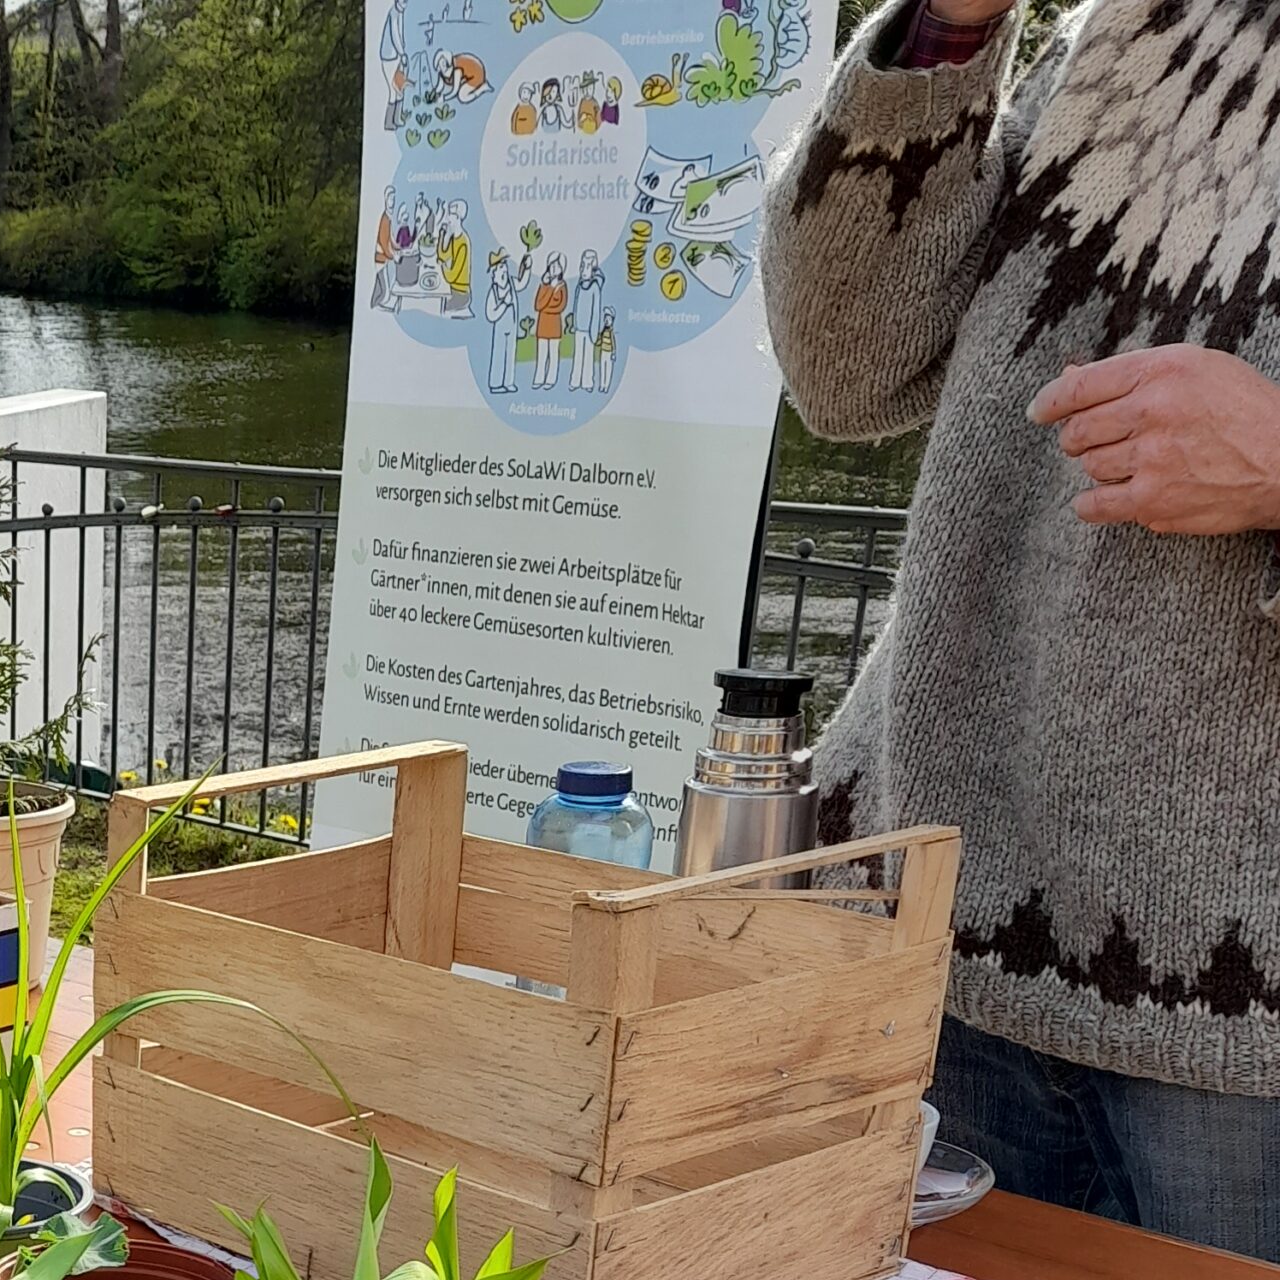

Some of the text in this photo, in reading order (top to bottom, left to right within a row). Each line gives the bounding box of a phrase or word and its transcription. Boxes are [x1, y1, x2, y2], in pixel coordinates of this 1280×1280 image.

[506, 139, 618, 167] Solidarische
[489, 175, 630, 202] Landwirtschaft
[509, 402, 576, 420] AckerBildung
[378, 450, 656, 489] Die Mitglieder des SoLaWi Dalborn e.V.
[376, 485, 621, 518] versorgen sich selbst mit Gemüse.
[373, 539, 682, 591] Dafür finanzieren sie zwei Arbeitsplätze für
[475, 582, 501, 601] mit
[503, 583, 552, 607] denen
[555, 590, 576, 610] sie
[579, 593, 608, 613] auf
[608, 596, 659, 620] einem
[662, 602, 705, 629] Hektar
[370, 598, 674, 656] über 40 leckere Gemüsesorten kultivieren.
[366, 654, 704, 727] Die Kosten des Gartenjahres, das Betriebsrisiko,
[364, 683, 682, 751] Wissen und Ernte werden solidarisch geteilt.
[507, 764, 557, 790] überne
